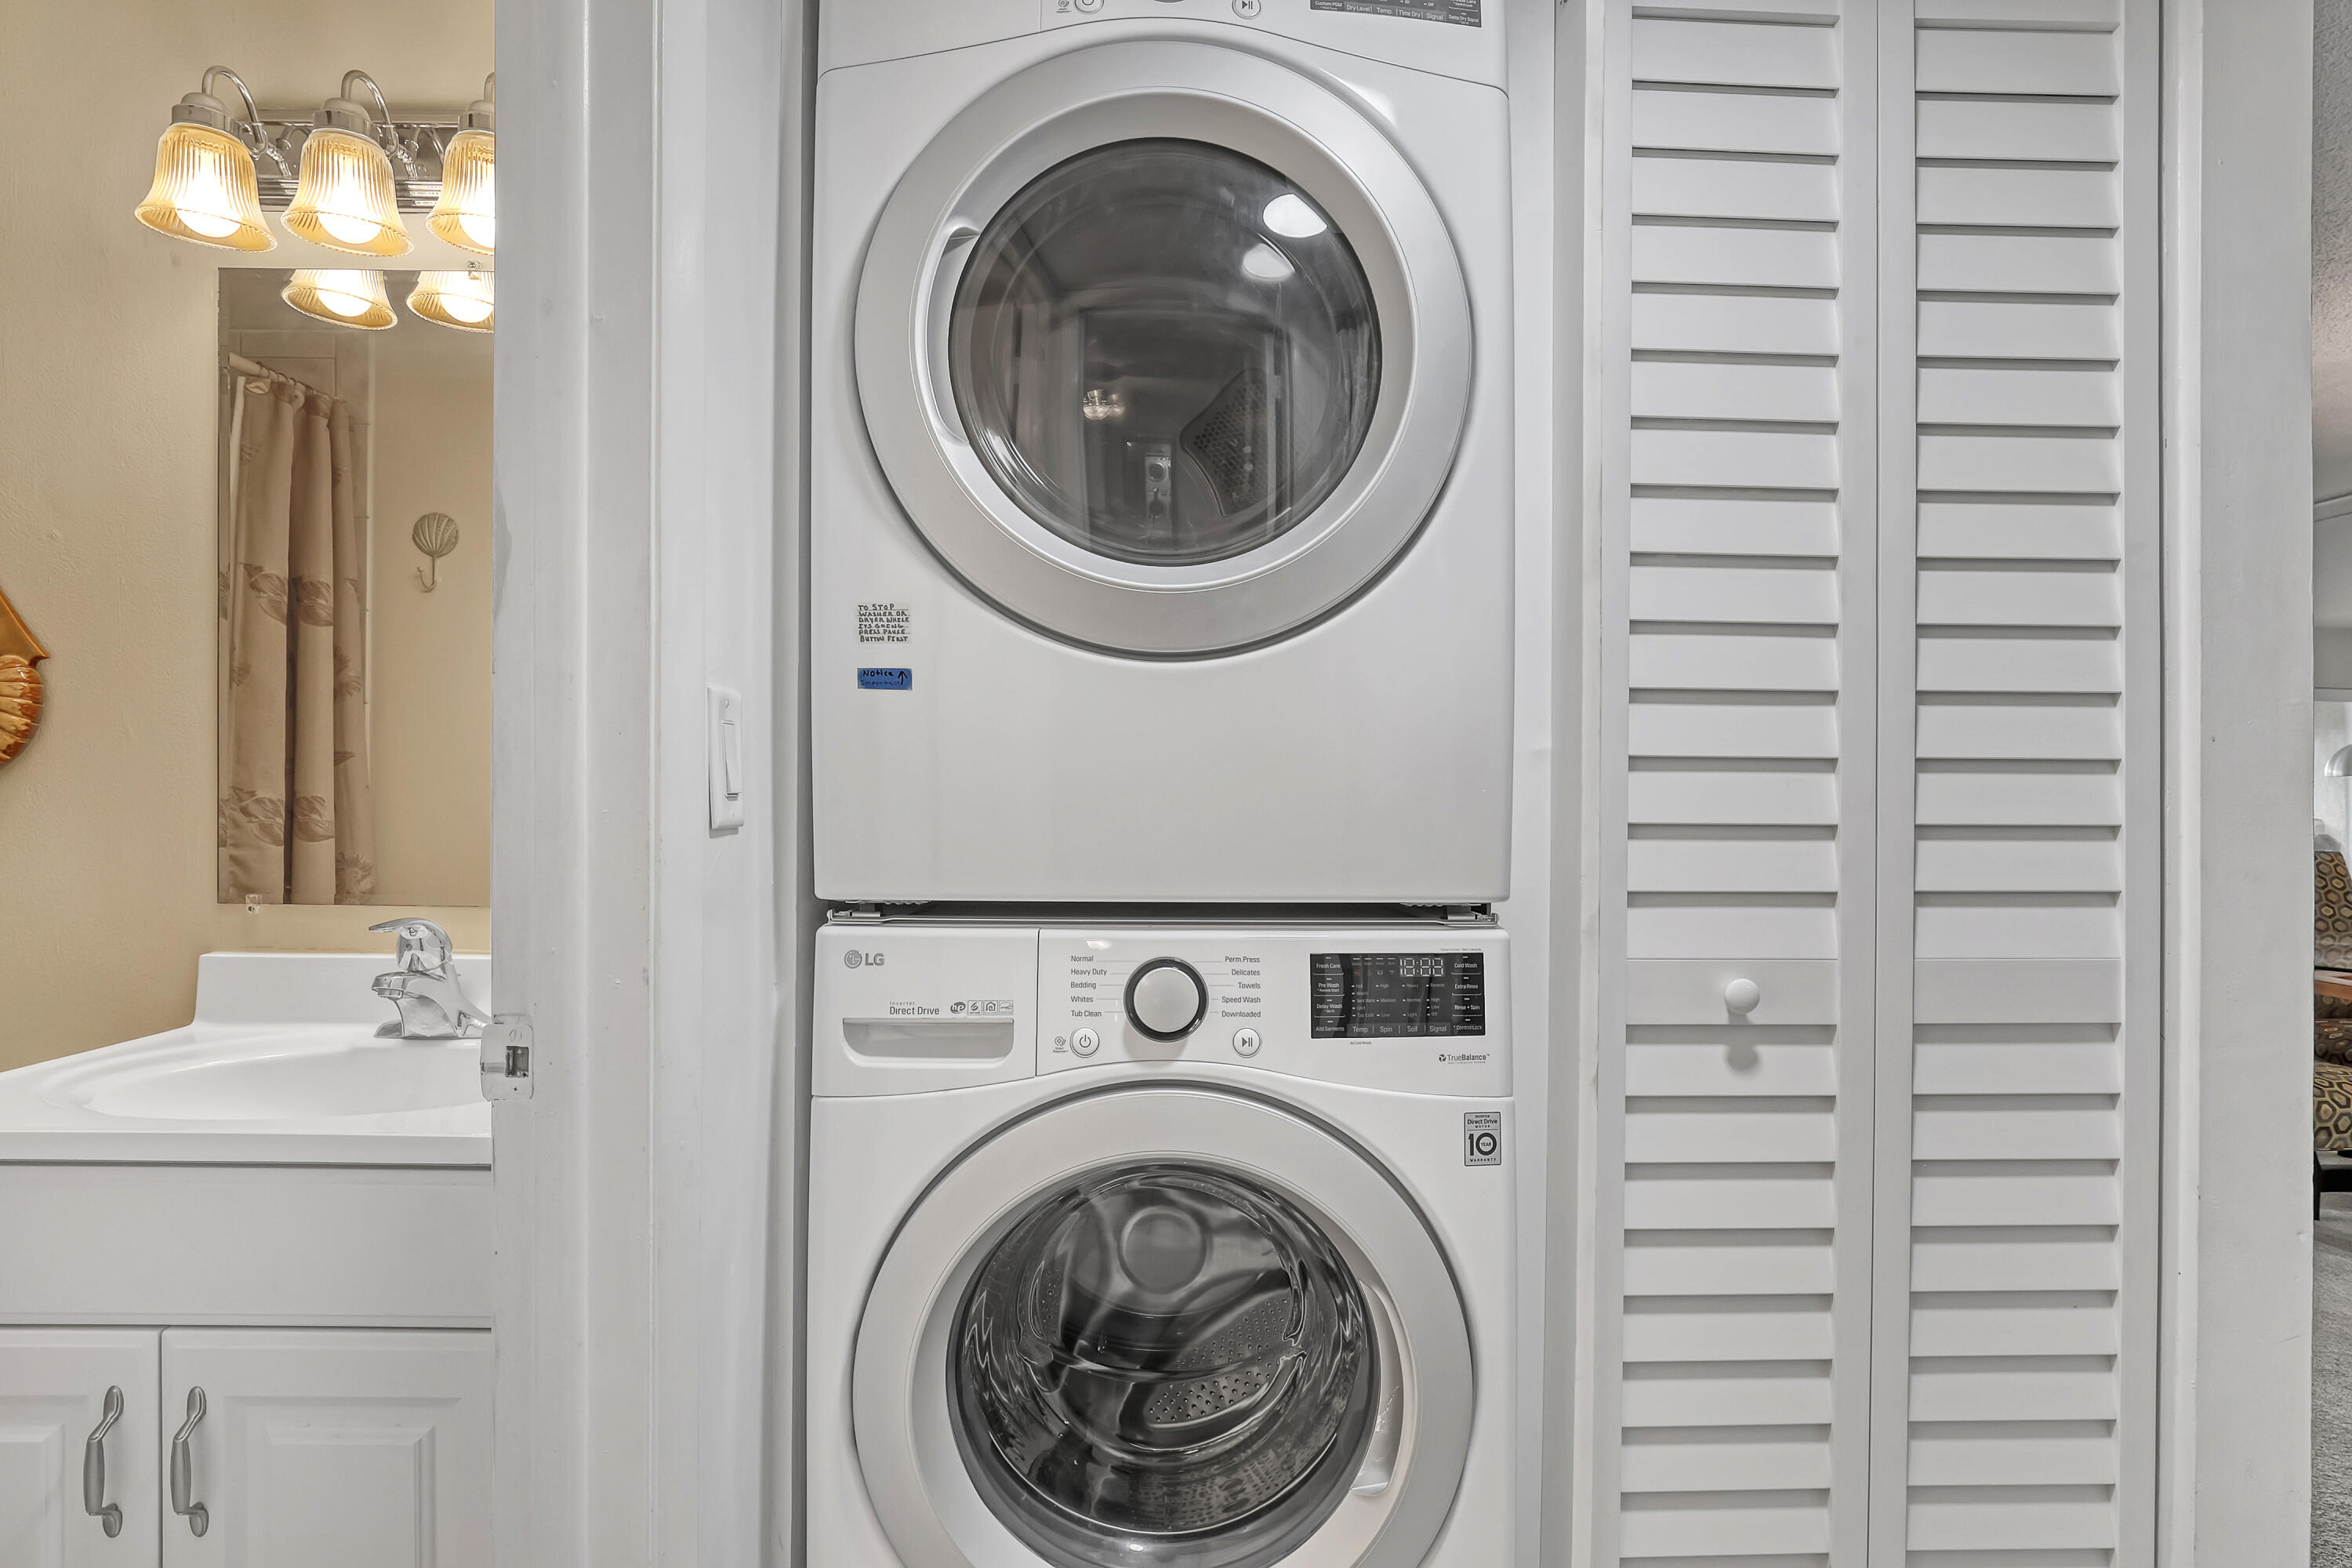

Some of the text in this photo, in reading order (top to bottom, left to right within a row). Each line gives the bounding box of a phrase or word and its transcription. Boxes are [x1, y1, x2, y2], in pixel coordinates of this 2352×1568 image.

[865, 953, 885, 966] LG
[1070, 982, 1097, 990] Bedding
[889, 1006, 940, 1015] Direct Drive
[1468, 1132, 1497, 1156] 10
